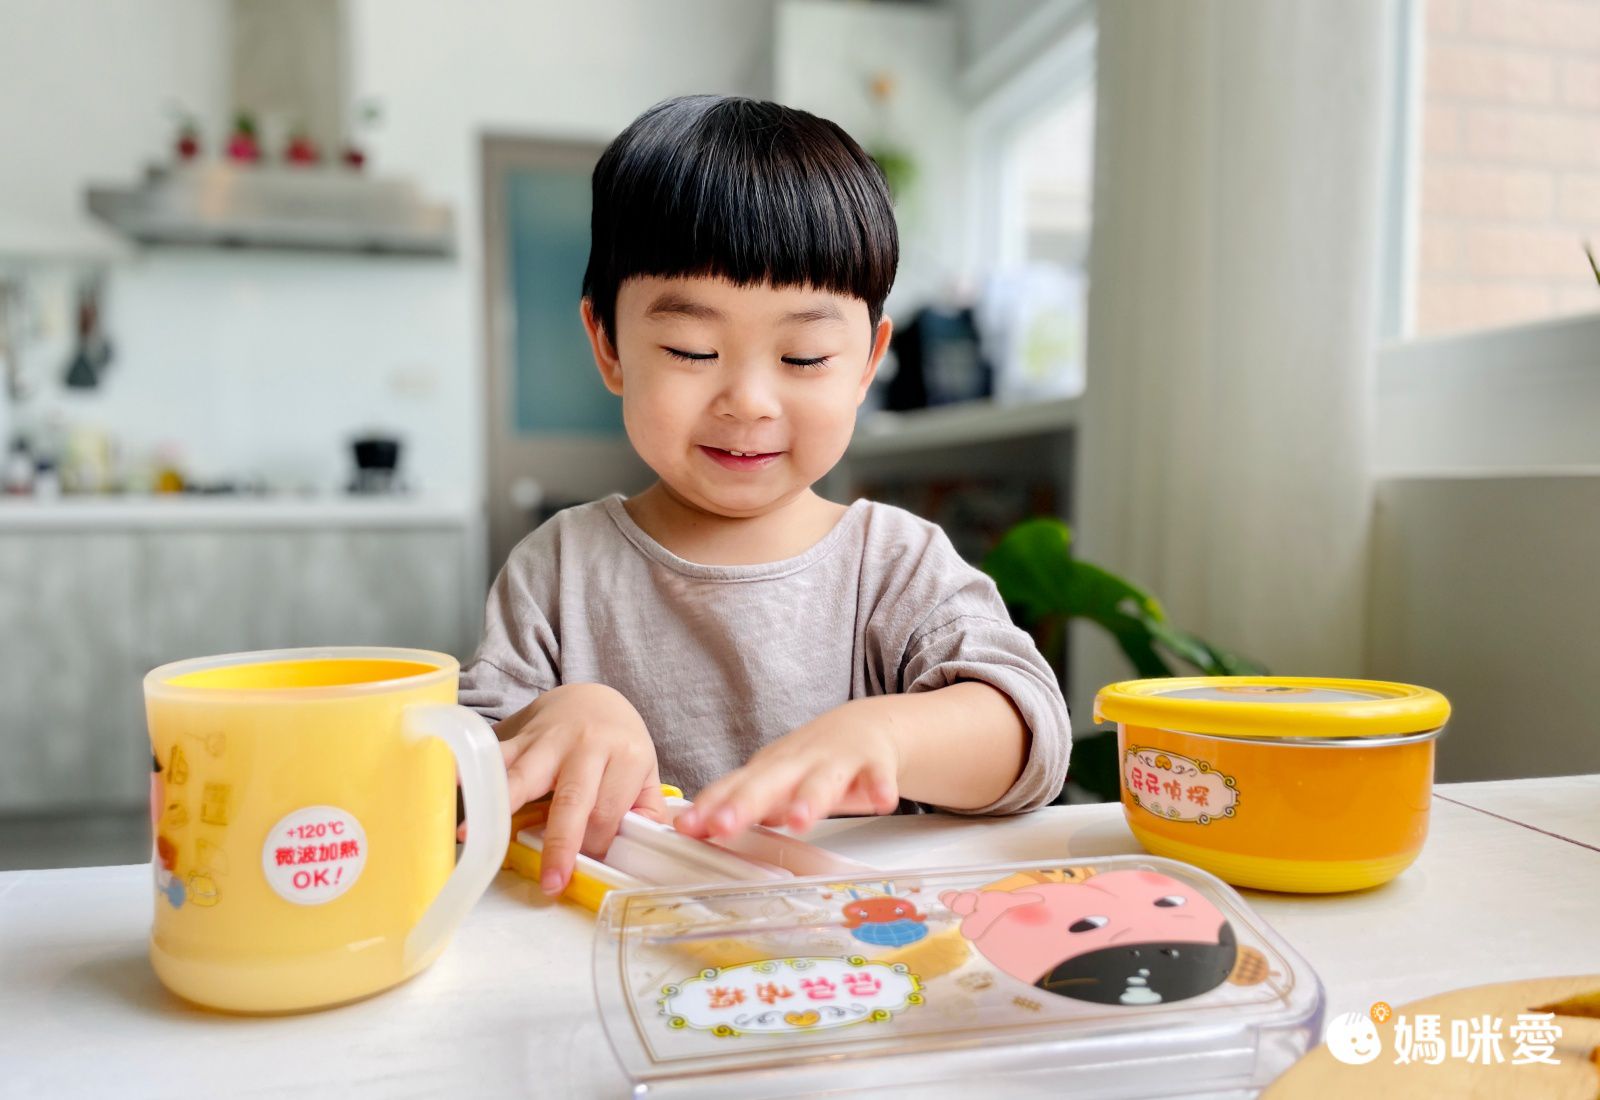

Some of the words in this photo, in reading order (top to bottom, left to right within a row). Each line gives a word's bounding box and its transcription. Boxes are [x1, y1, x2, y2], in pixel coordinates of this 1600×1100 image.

[275, 839, 359, 866] 微波加熱
[293, 866, 343, 890] OK!
